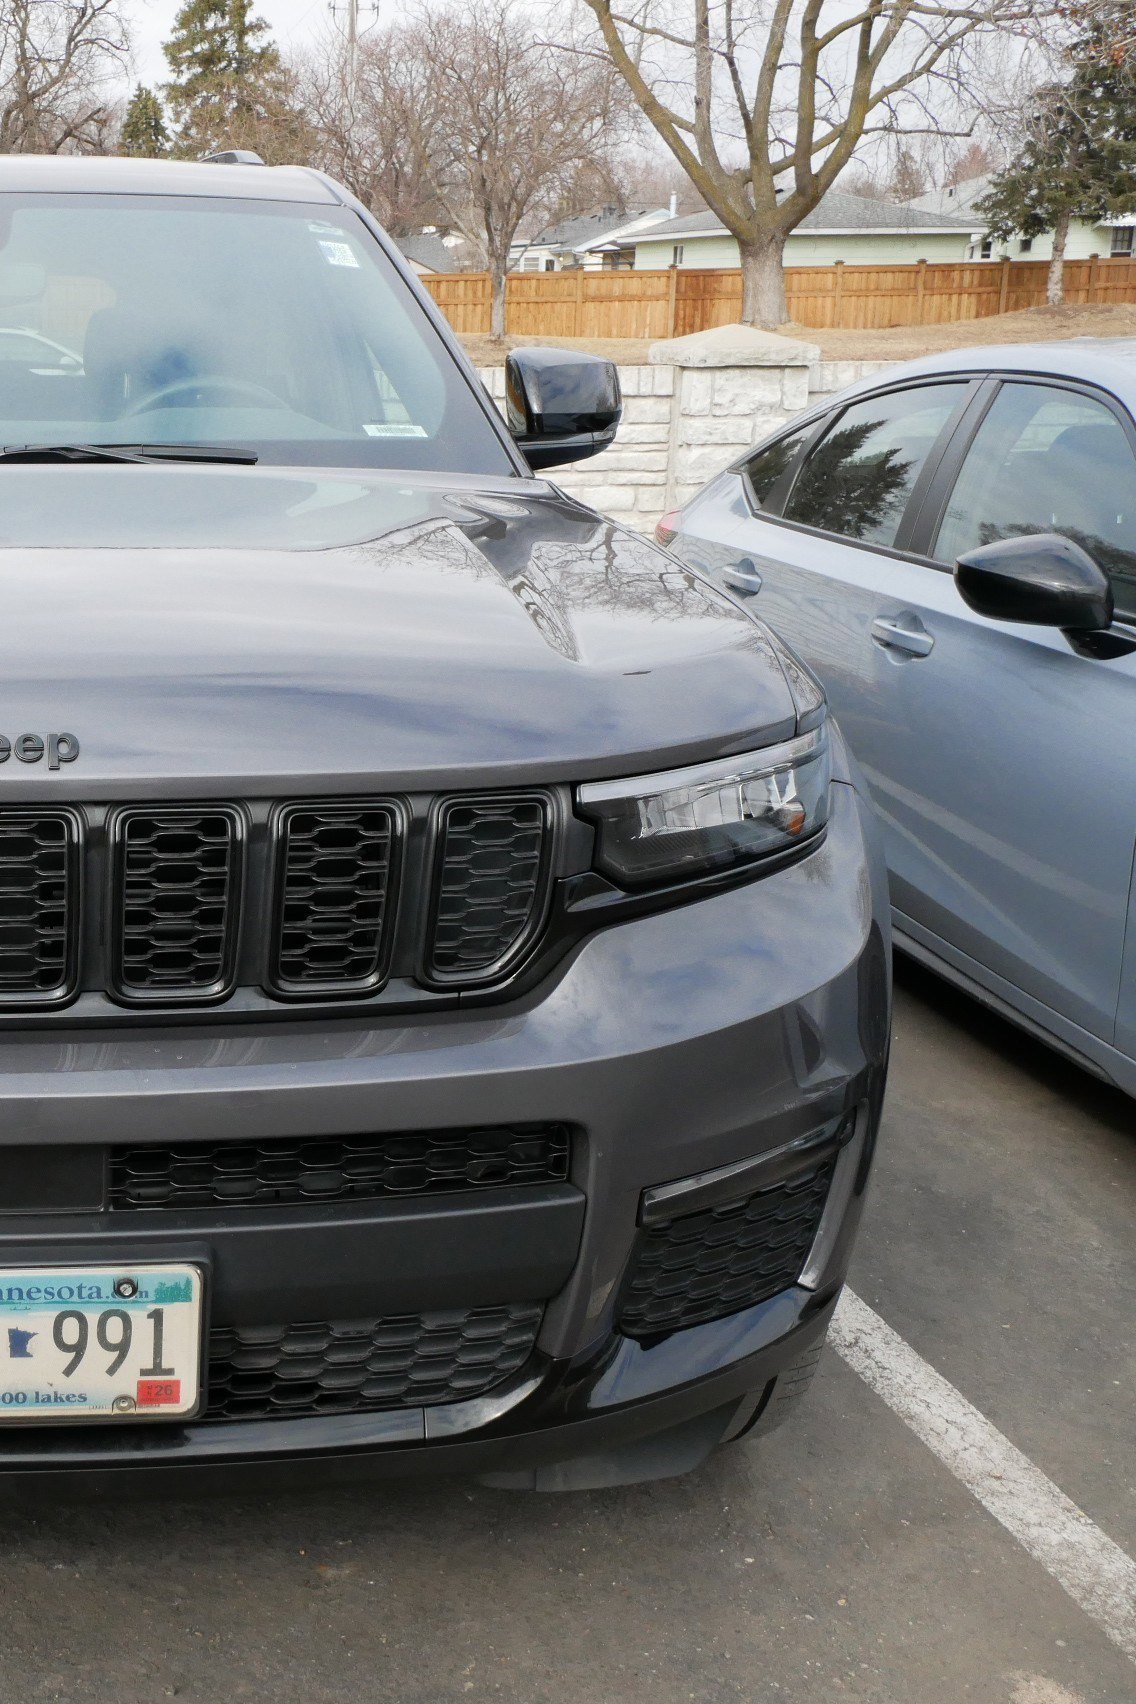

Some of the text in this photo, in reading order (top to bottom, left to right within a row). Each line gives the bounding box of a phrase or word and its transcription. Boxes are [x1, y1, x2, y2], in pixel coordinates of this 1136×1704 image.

[52, 1307, 176, 1378] 991
[34, 1390, 88, 1404] lakes
[155, 1384, 173, 1396] 26
